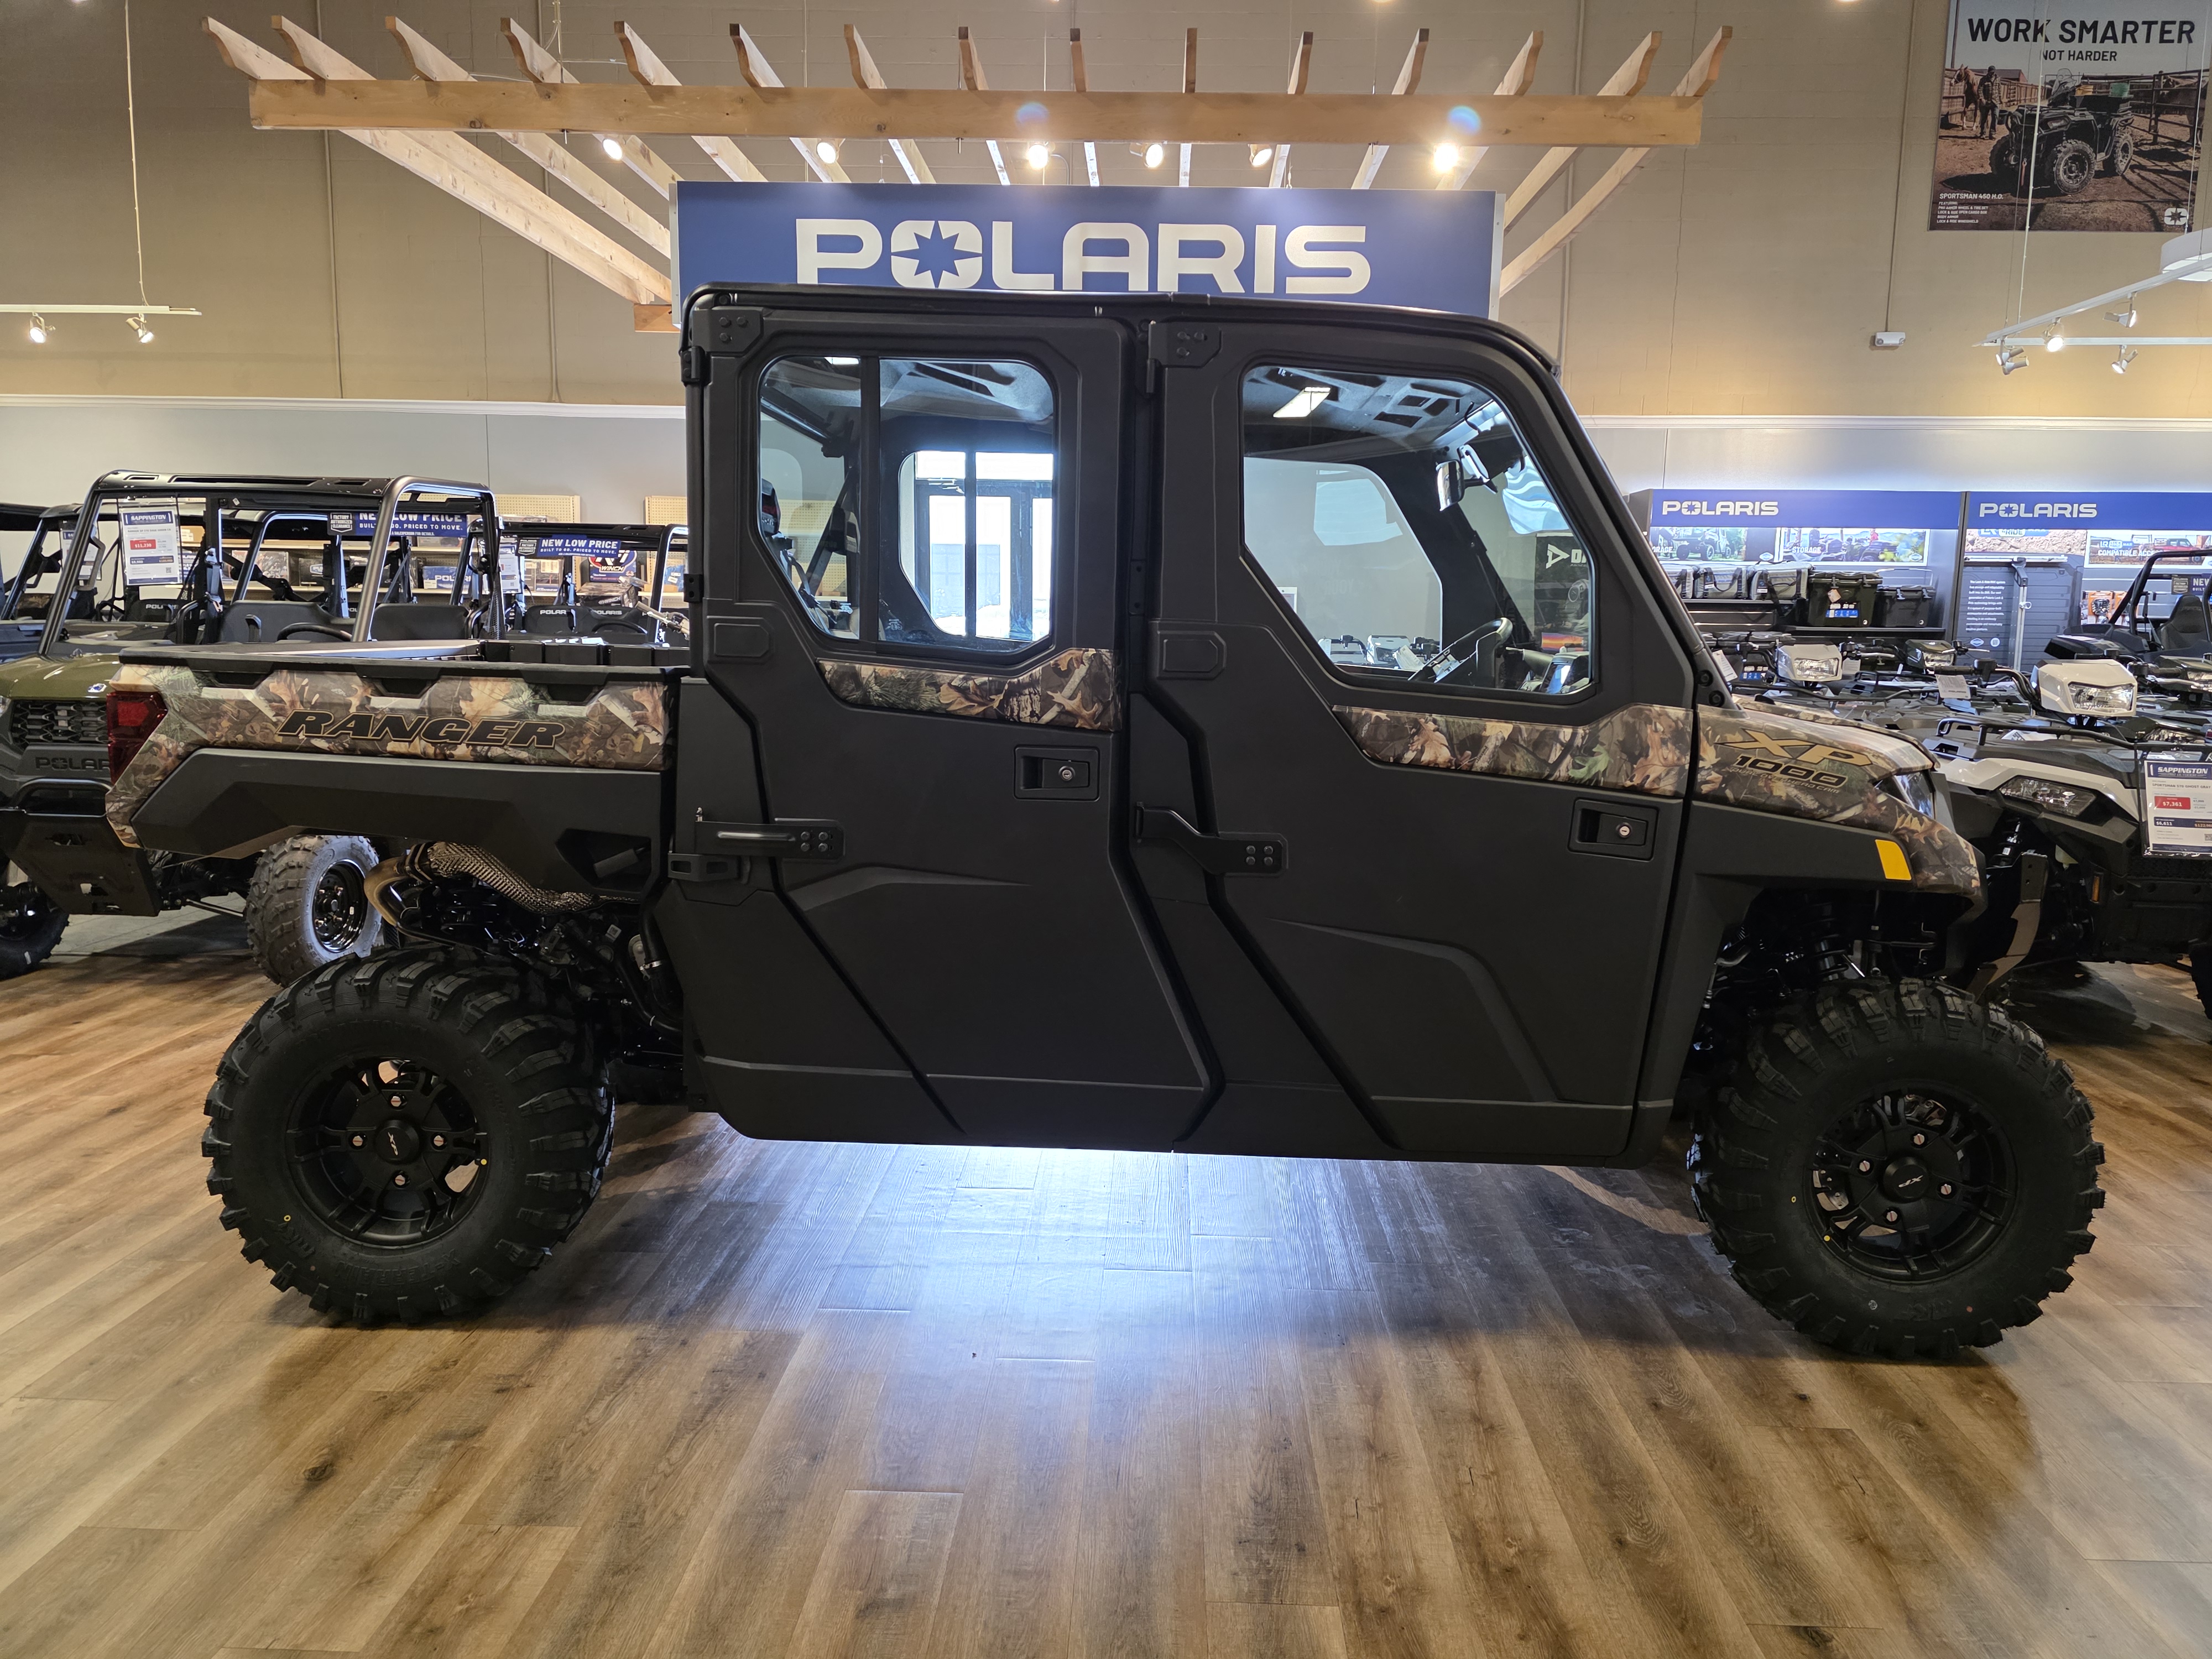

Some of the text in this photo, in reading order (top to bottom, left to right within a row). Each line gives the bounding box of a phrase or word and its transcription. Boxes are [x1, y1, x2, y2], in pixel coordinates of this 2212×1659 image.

[1968, 18, 2196, 44] WORK SMARTER
[2040, 49, 2117, 62] NOT HARDER
[796, 218, 1371, 295] POLARIS
[1662, 500, 1779, 516] POLARIS
[1979, 503, 2097, 518] POLARIS
[588, 540, 618, 549] PRICE
[276, 708, 565, 749] RANGER
[1714, 727, 1874, 767] XP
[35, 757, 111, 771] POLAR
[1733, 753, 1849, 789] 1000
[1817, 785, 1840, 794] CAM
[387, 1131, 399, 1156] XP
[1898, 1175, 1924, 1188] XP
